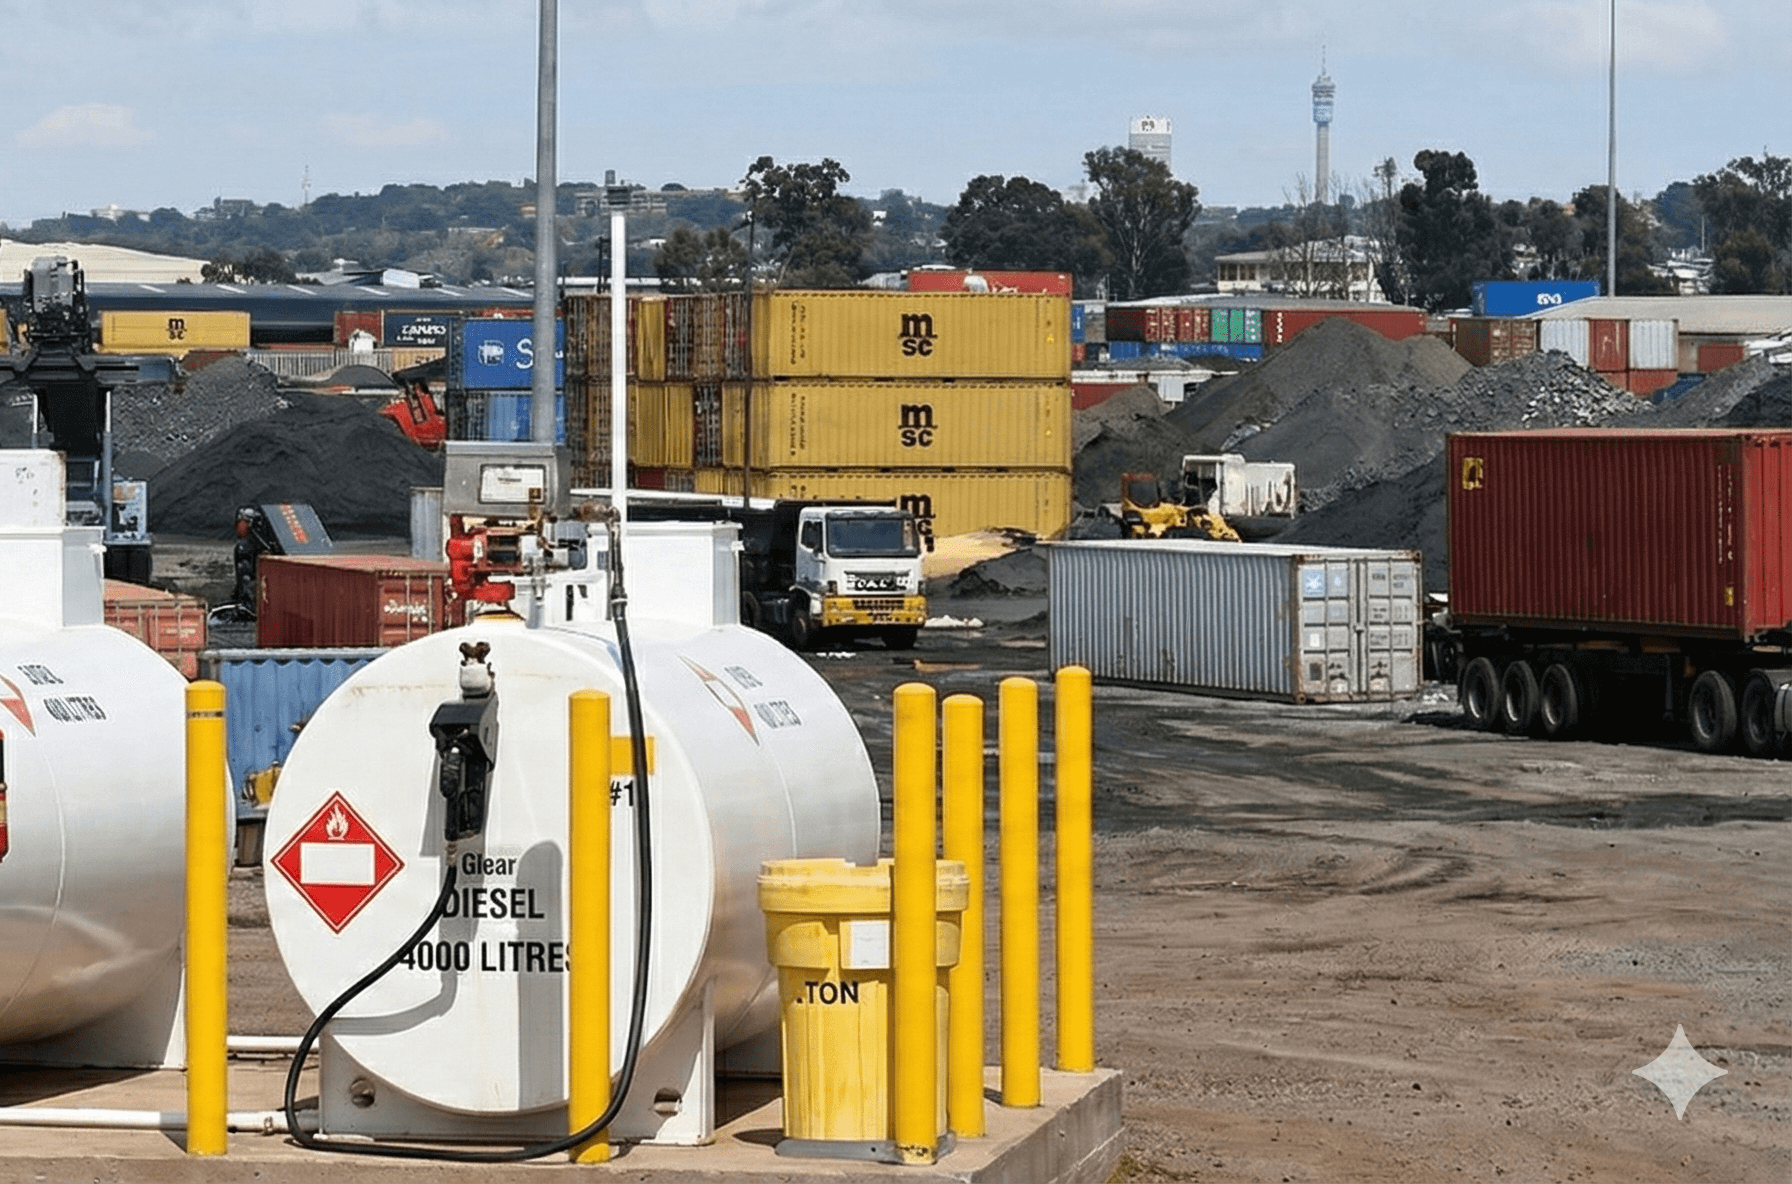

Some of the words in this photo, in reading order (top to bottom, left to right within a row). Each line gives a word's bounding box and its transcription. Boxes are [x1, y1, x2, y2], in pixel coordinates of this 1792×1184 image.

[610, 780, 634, 807] #1
[442, 888, 545, 919] DIESEL
[399, 941, 470, 972] 4000
